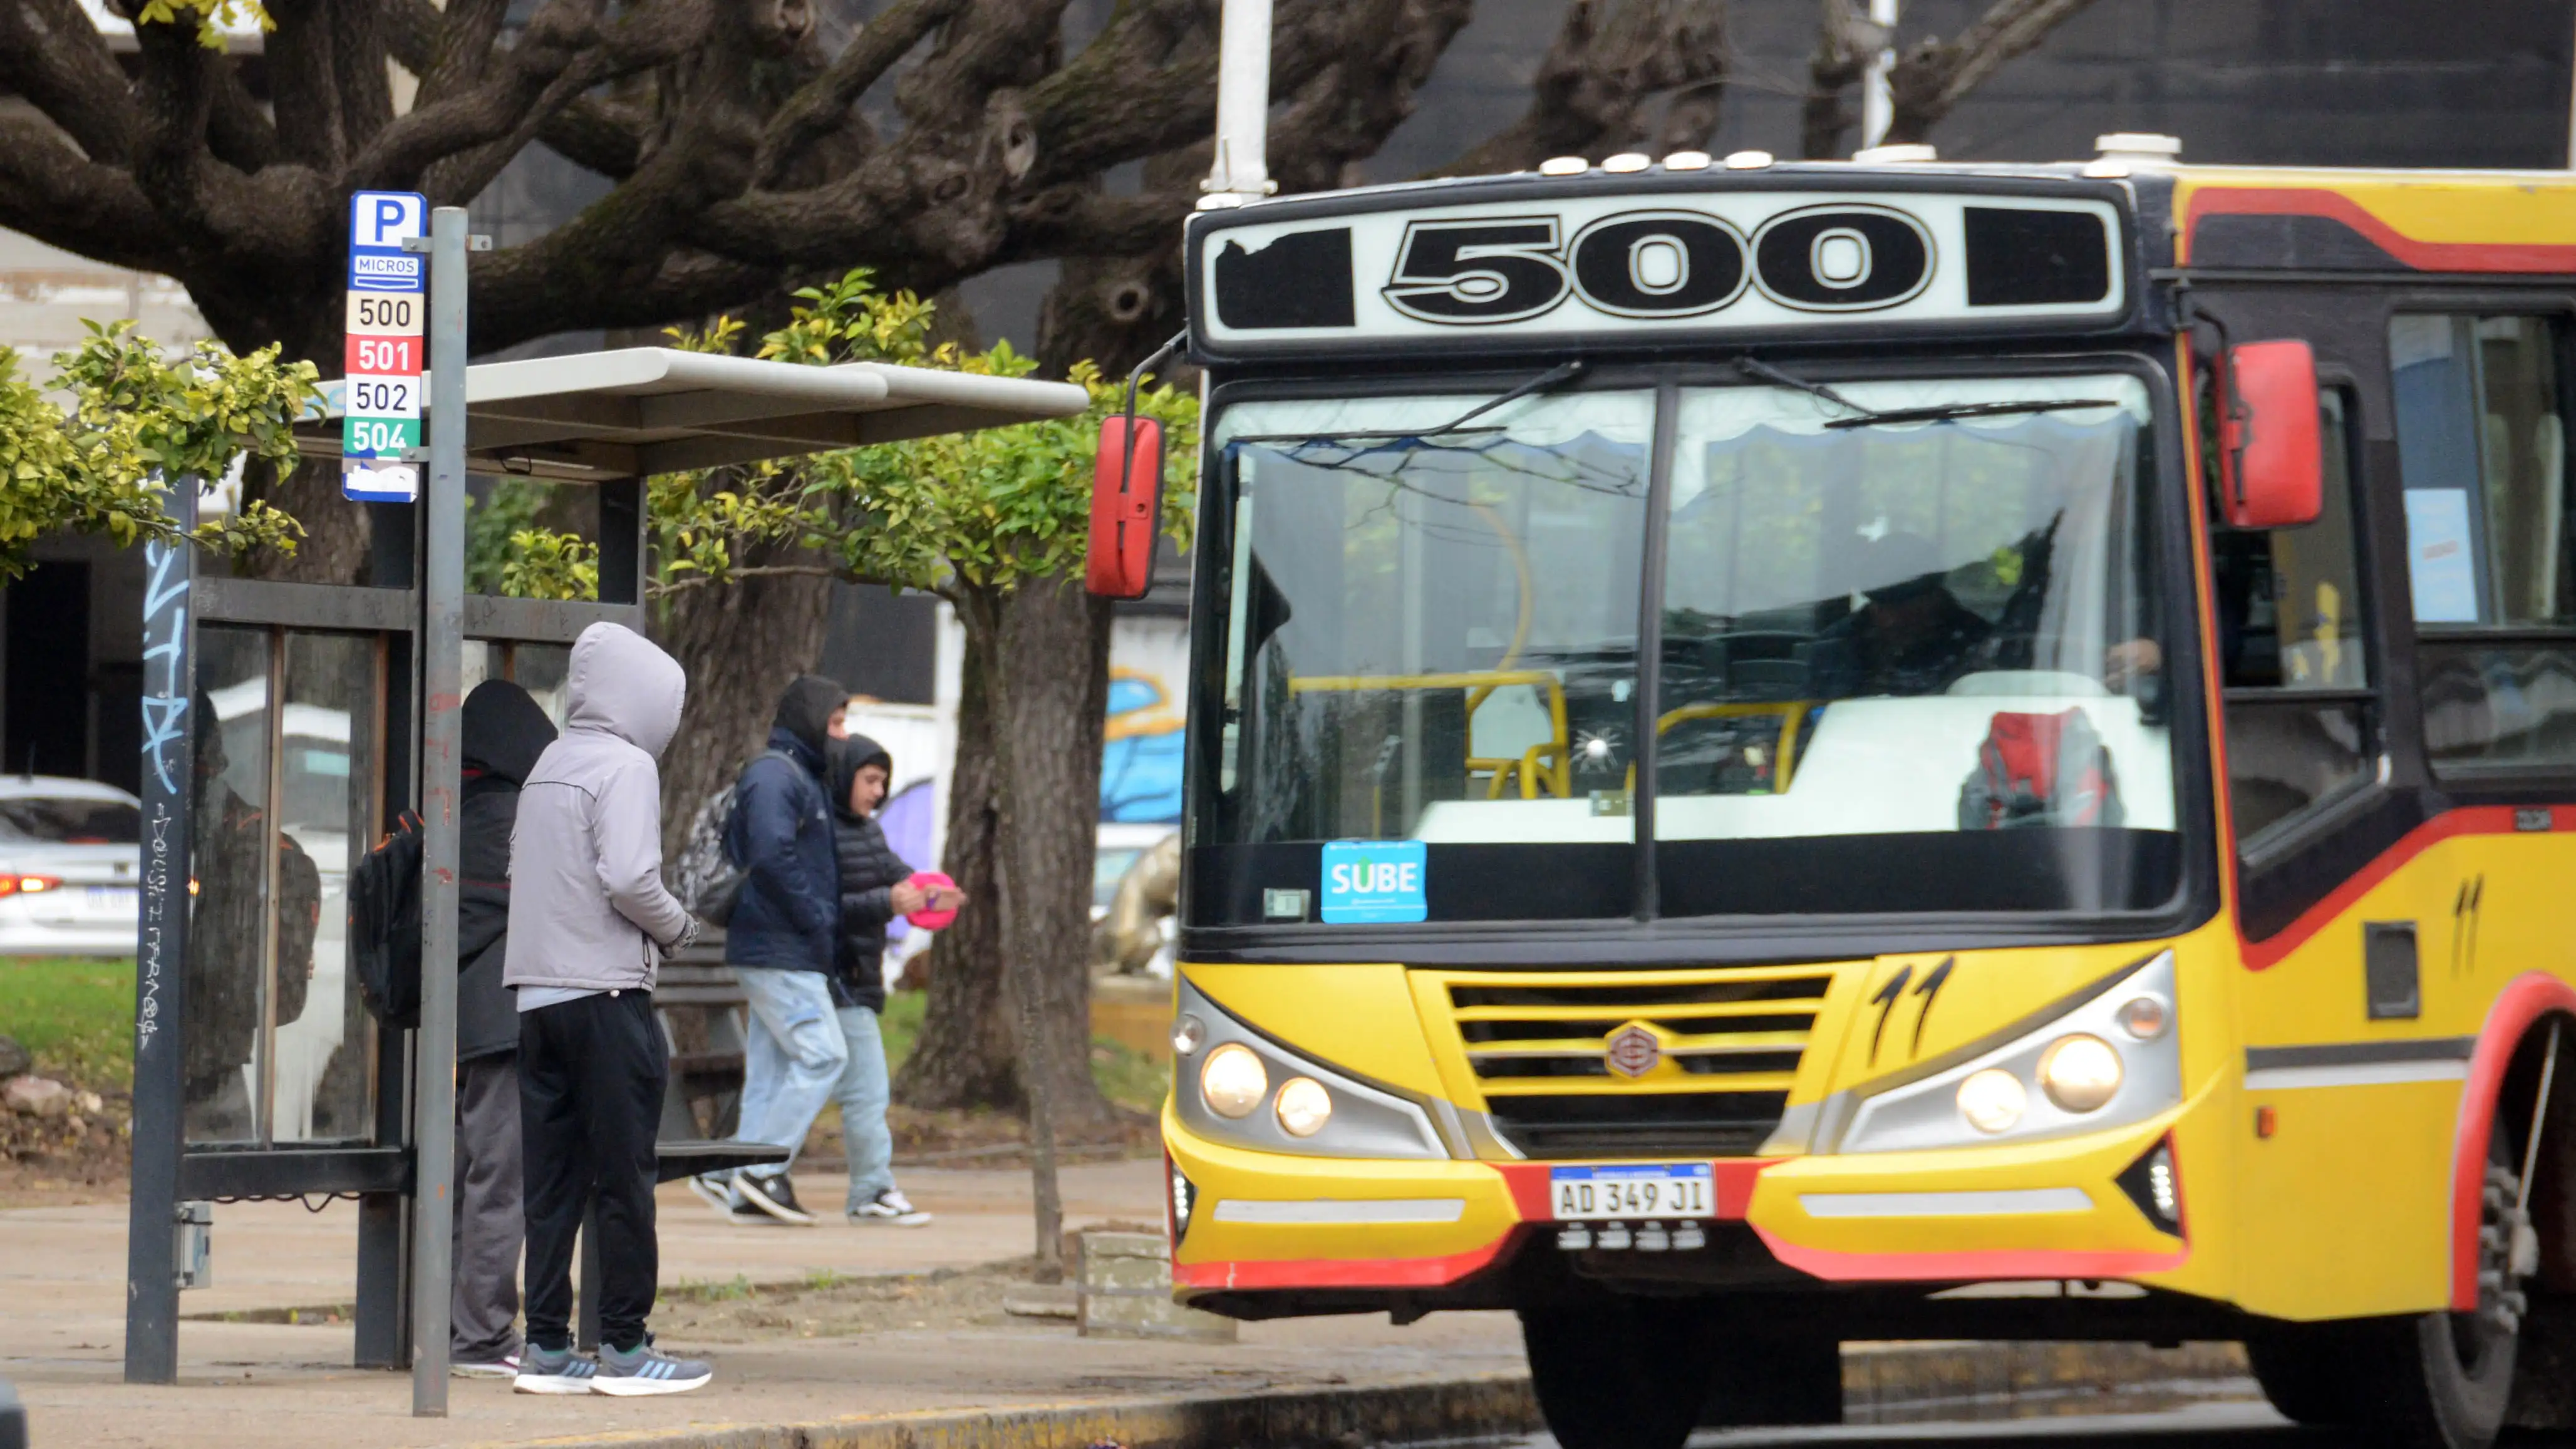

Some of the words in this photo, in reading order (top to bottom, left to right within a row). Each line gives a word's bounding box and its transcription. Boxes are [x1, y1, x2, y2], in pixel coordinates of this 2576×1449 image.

[375, 199, 406, 242] P
[359, 259, 415, 273] MICROS
[1380, 202, 1940, 325] 500
[359, 298, 411, 327] 500
[358, 340, 408, 371] 501
[356, 382, 408, 412] 502
[353, 421, 406, 452] 504
[1331, 862, 1418, 894] SUBE
[1868, 954, 1954, 1066] 11
[1561, 1183, 1595, 1213] AD
[1605, 1183, 1658, 1212] 349
[1670, 1181, 1705, 1210] JI
